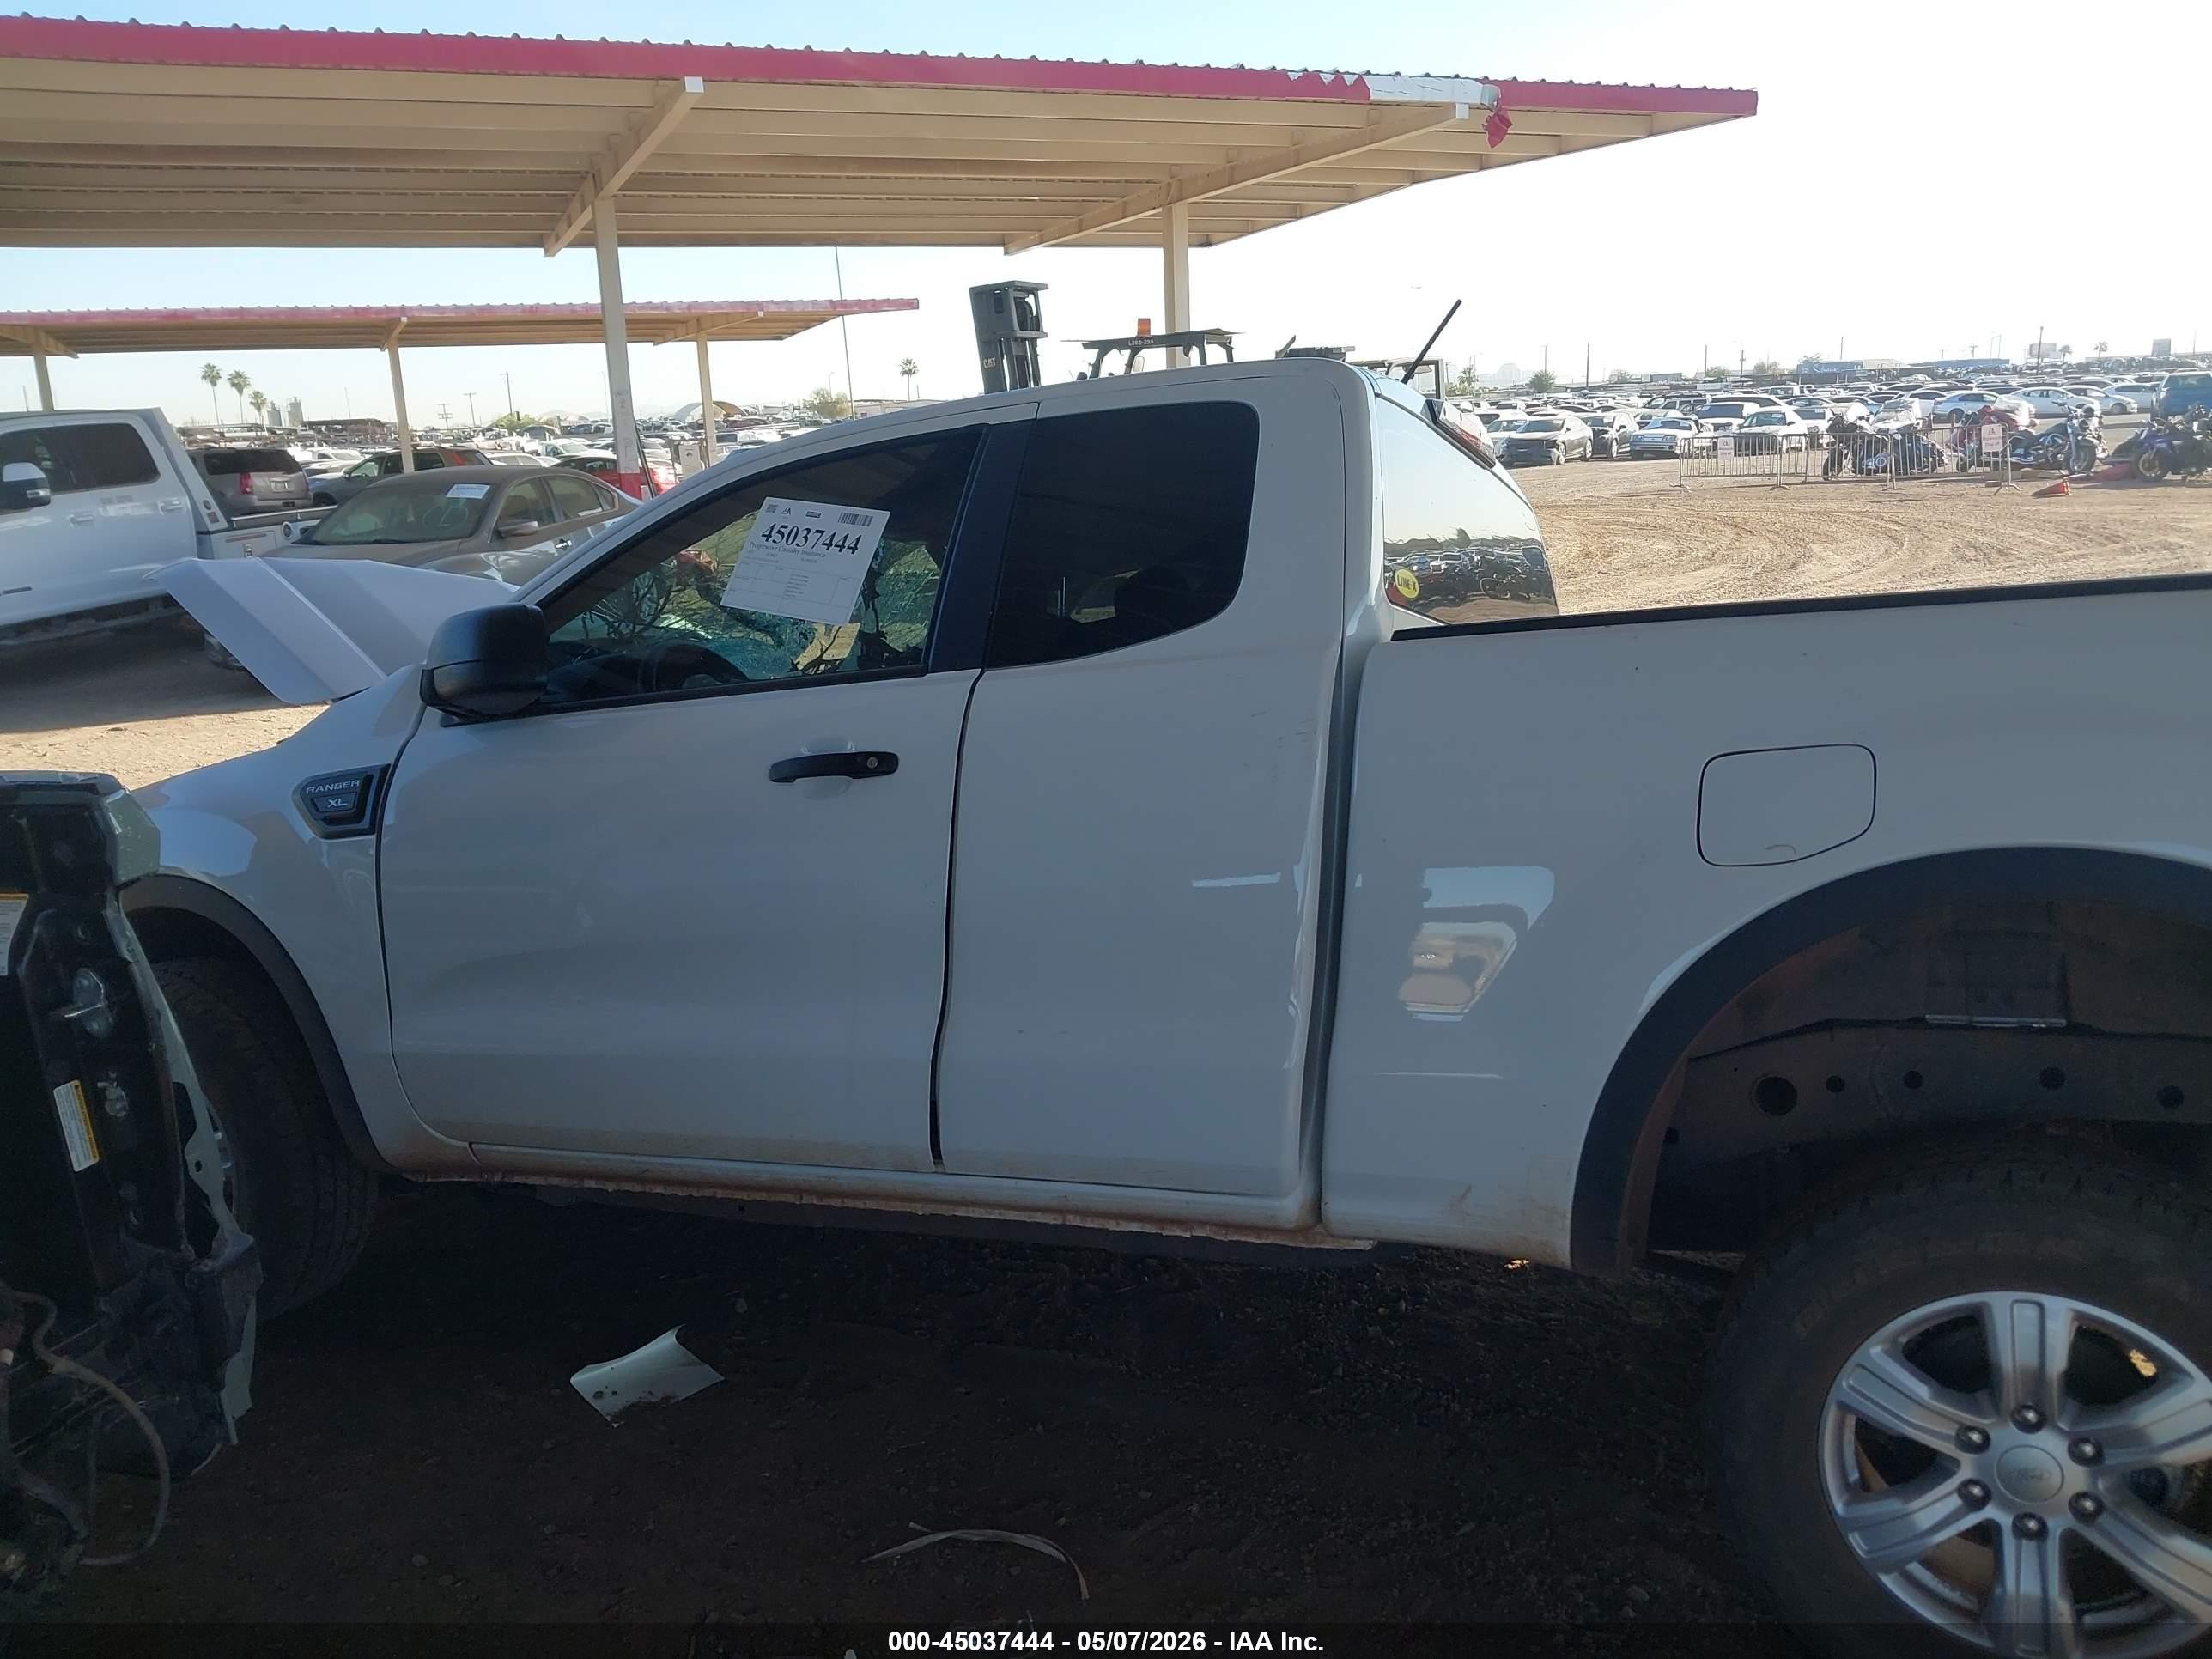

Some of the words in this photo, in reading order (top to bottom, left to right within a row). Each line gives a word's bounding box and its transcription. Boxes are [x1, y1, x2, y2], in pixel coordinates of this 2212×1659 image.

[983, 357, 996, 368] CAT
[761, 523, 863, 556] 45037444
[306, 780, 361, 794] RANGER
[327, 798, 349, 808] XL
